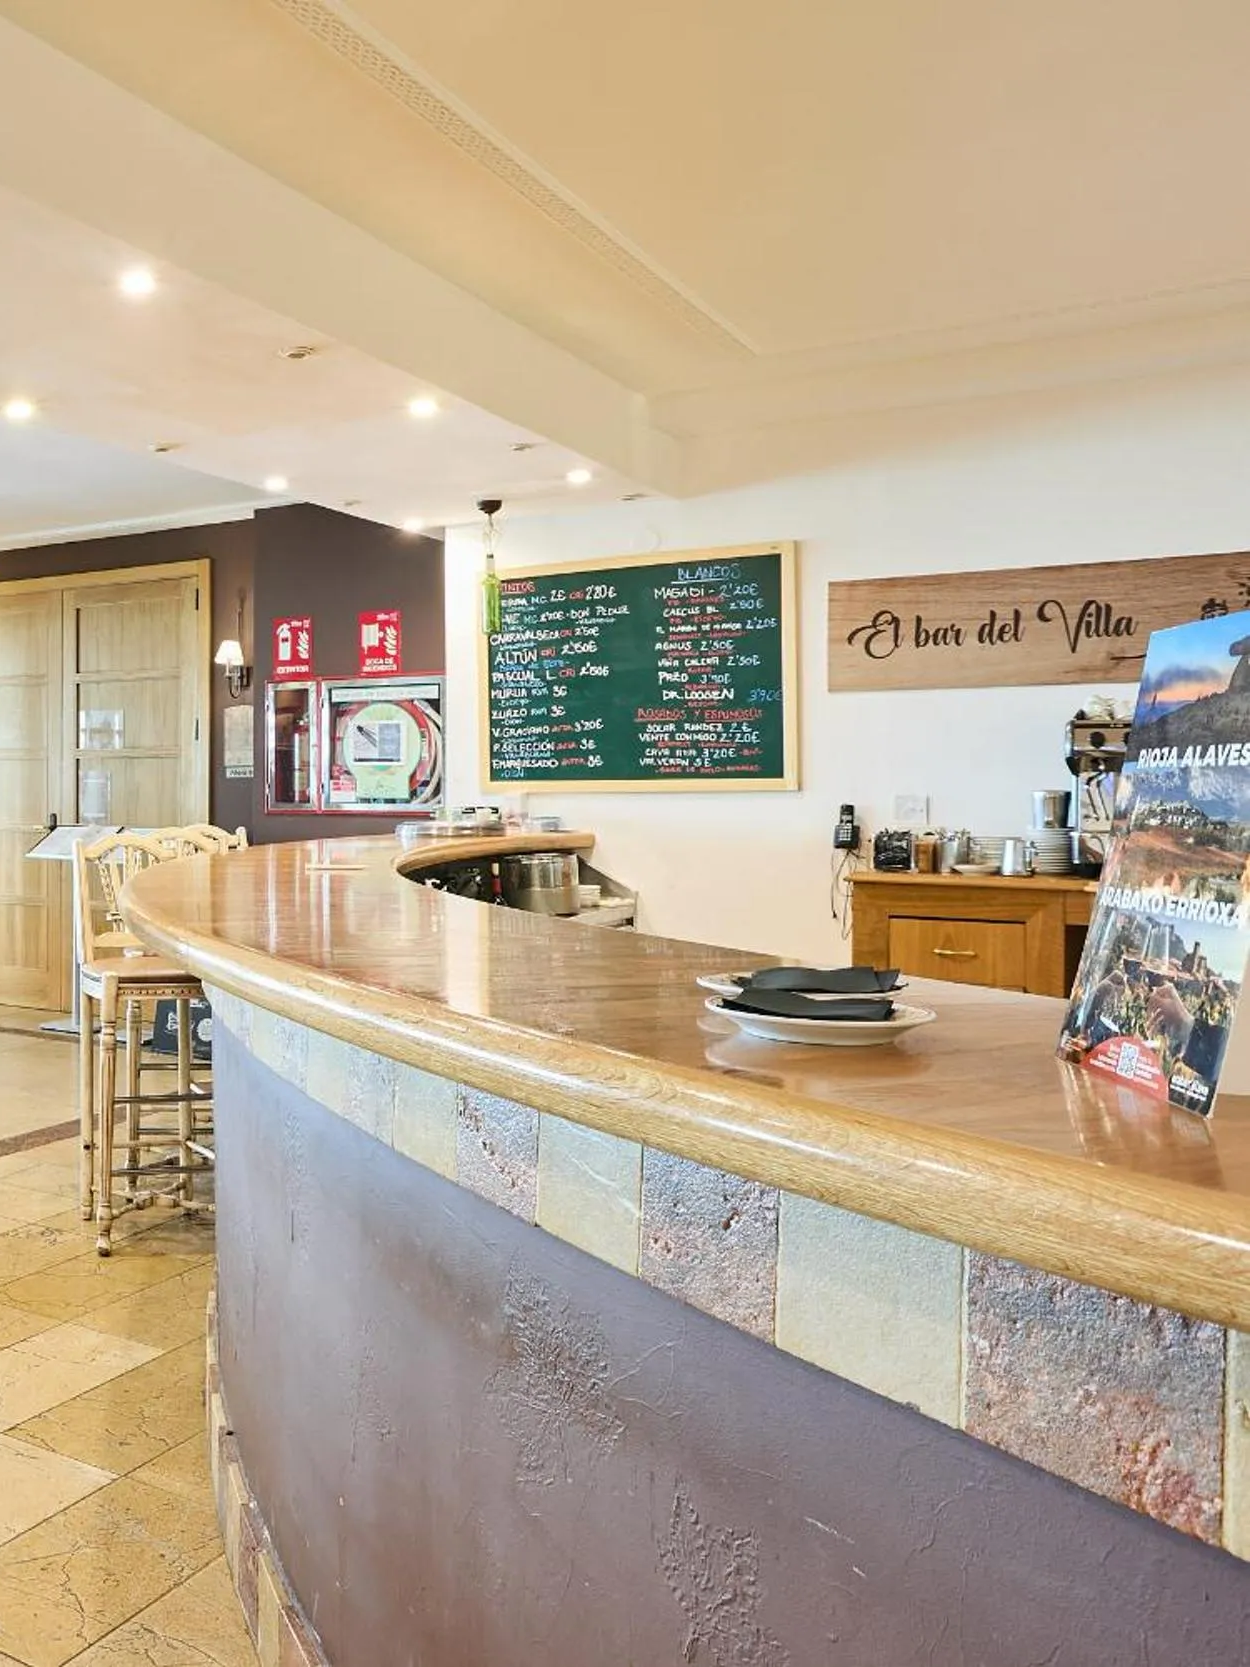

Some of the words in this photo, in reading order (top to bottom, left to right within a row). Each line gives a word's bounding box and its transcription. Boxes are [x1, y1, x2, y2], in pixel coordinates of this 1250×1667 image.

[678, 563, 741, 580] BLANCOS
[847, 610, 903, 659] El
[914, 615, 966, 648] bar
[977, 608, 1024, 646] del
[1036, 599, 1139, 654] Villa
[1137, 746, 1178, 770] RIOJA
[1181, 743, 1250, 768] ALAVES
[1166, 897, 1243, 929] ERRIOXA
